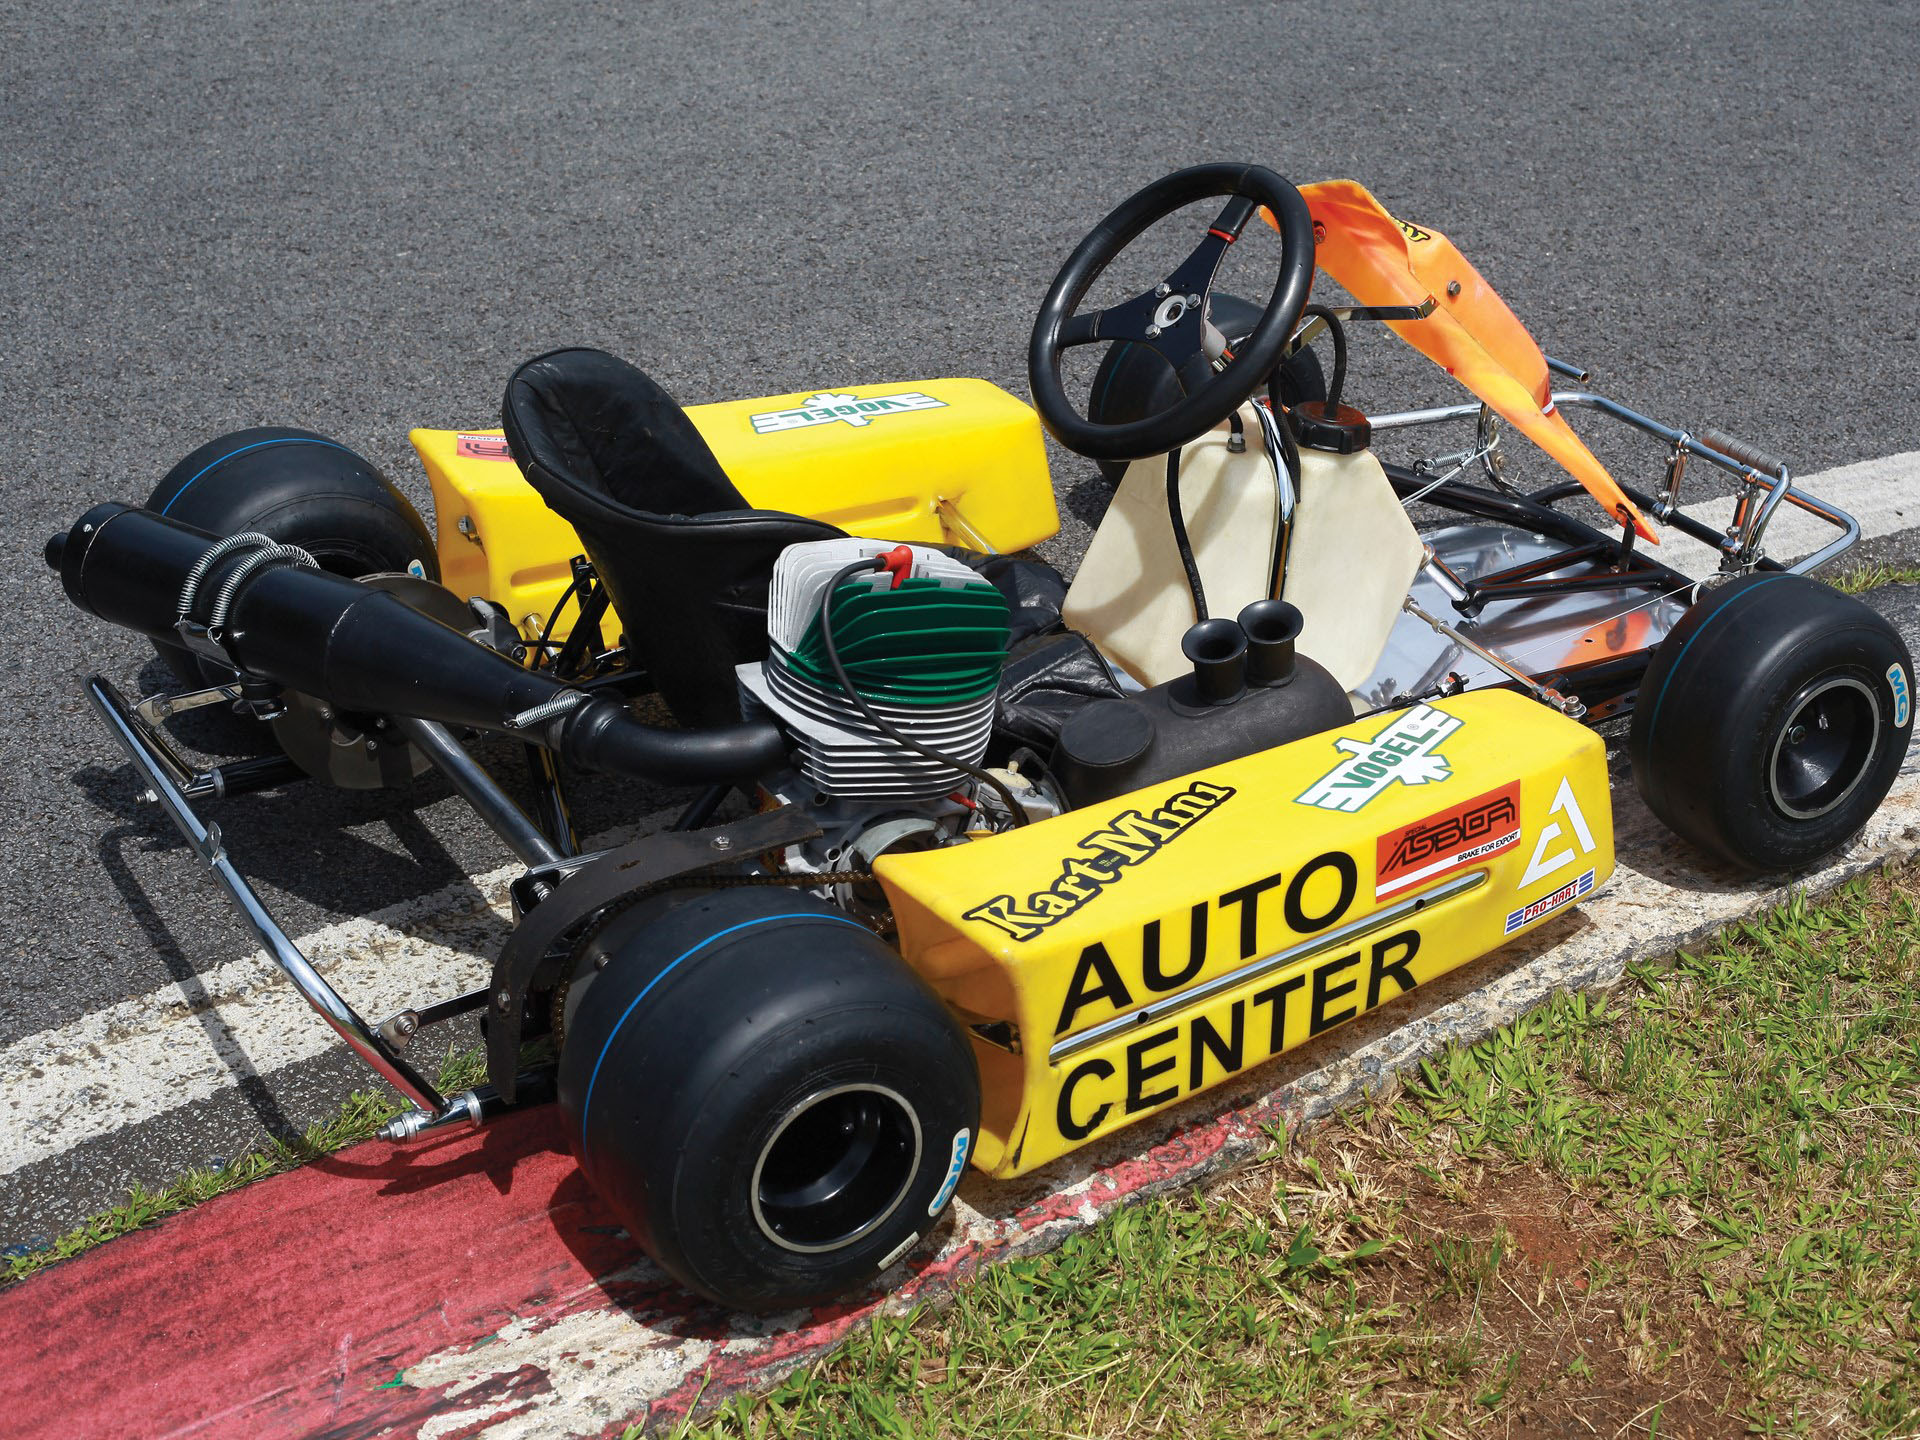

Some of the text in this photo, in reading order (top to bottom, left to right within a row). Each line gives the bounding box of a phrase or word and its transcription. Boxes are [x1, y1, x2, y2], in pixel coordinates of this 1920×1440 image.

[779, 399, 910, 422] VOGEL
[1889, 669, 1907, 723] MG
[1329, 728, 1440, 789] VOGEL
[1457, 831, 1519, 862] BRAKE FOR EXPORT
[1523, 883, 1578, 921] PRO-HART
[1054, 851, 1358, 1036] AUTO
[1056, 929, 1422, 1141] CENTER
[933, 1136, 968, 1209] MG
